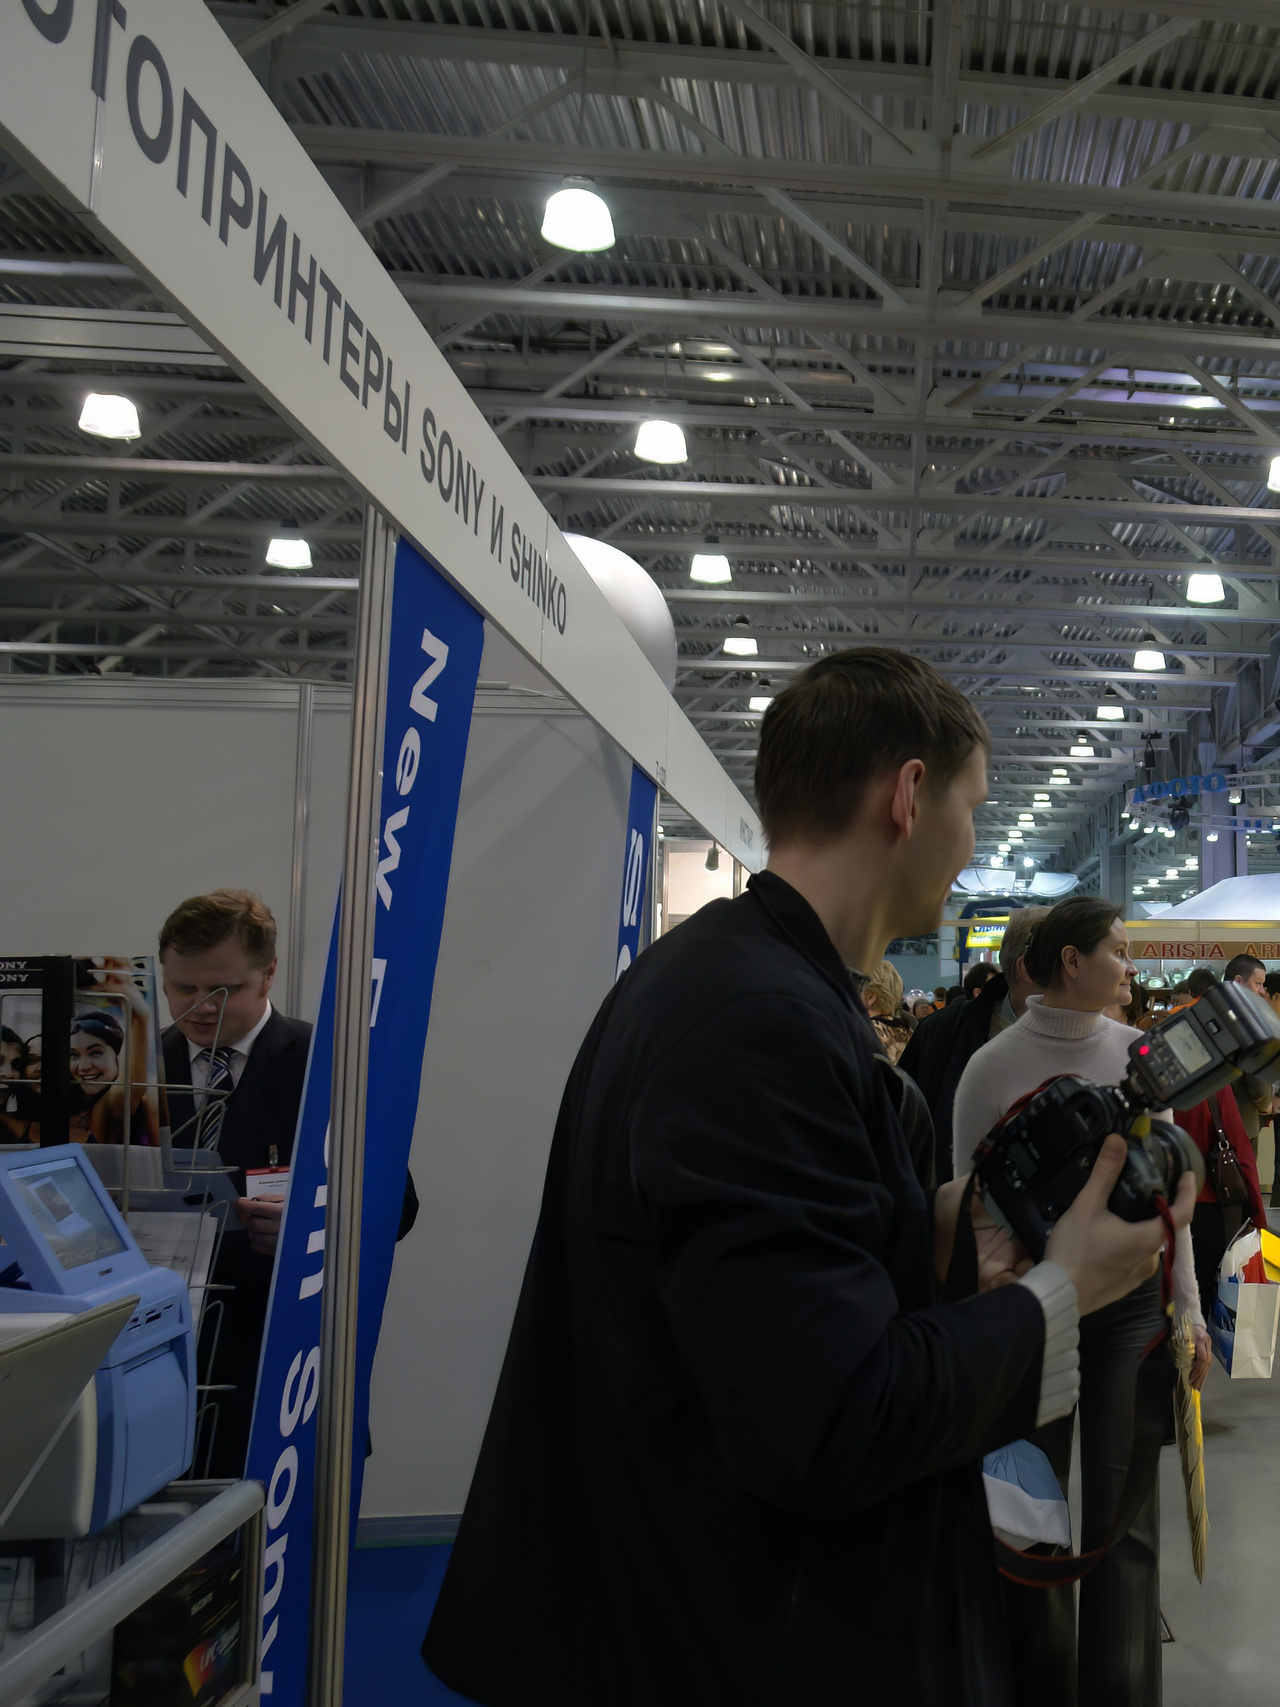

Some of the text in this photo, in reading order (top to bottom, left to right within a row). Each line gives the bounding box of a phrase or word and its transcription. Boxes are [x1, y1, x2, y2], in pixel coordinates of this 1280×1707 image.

[420, 407, 486, 537] SONY
[510, 521, 569, 636] SHINKO
[1142, 943, 1225, 959] ARISTA
